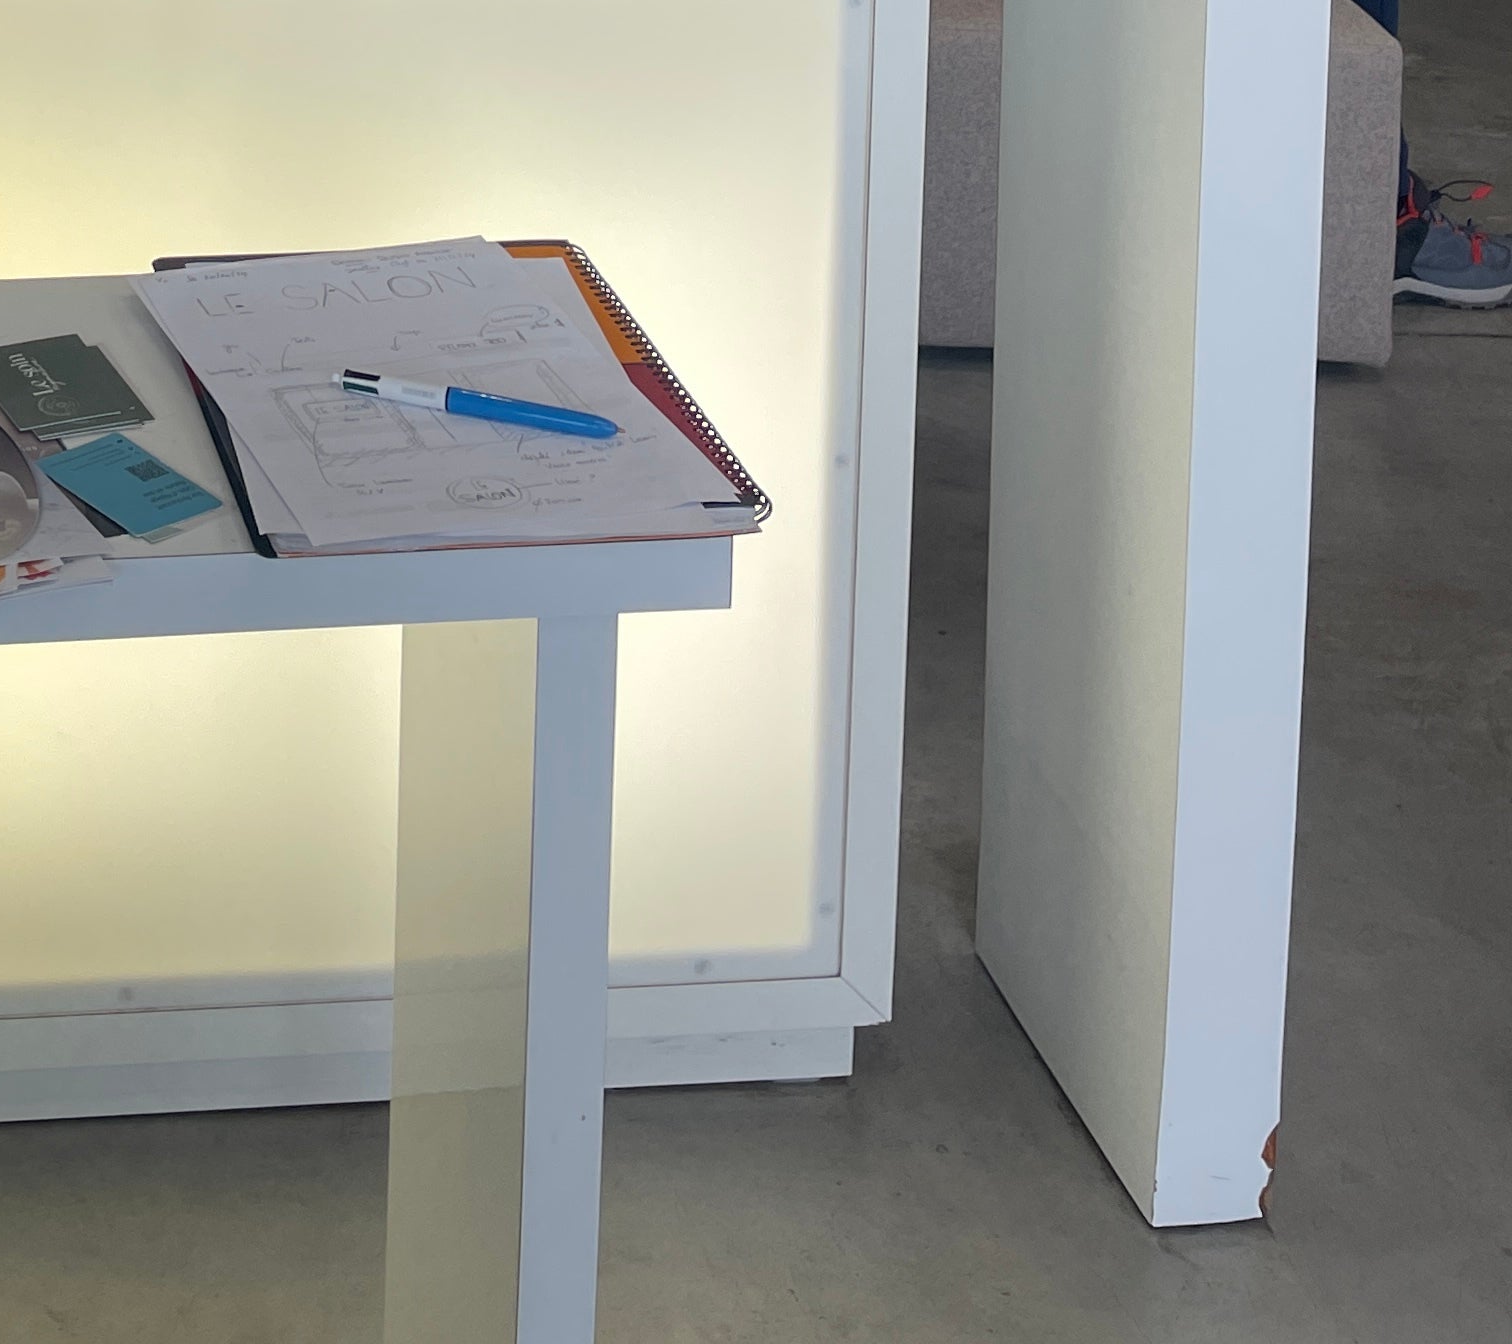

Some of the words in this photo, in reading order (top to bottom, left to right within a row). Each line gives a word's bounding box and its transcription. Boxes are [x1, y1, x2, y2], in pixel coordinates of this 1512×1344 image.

[196, 292, 256, 318] LE
[281, 265, 477, 311] SALON
[458, 486, 517, 504] SALON
